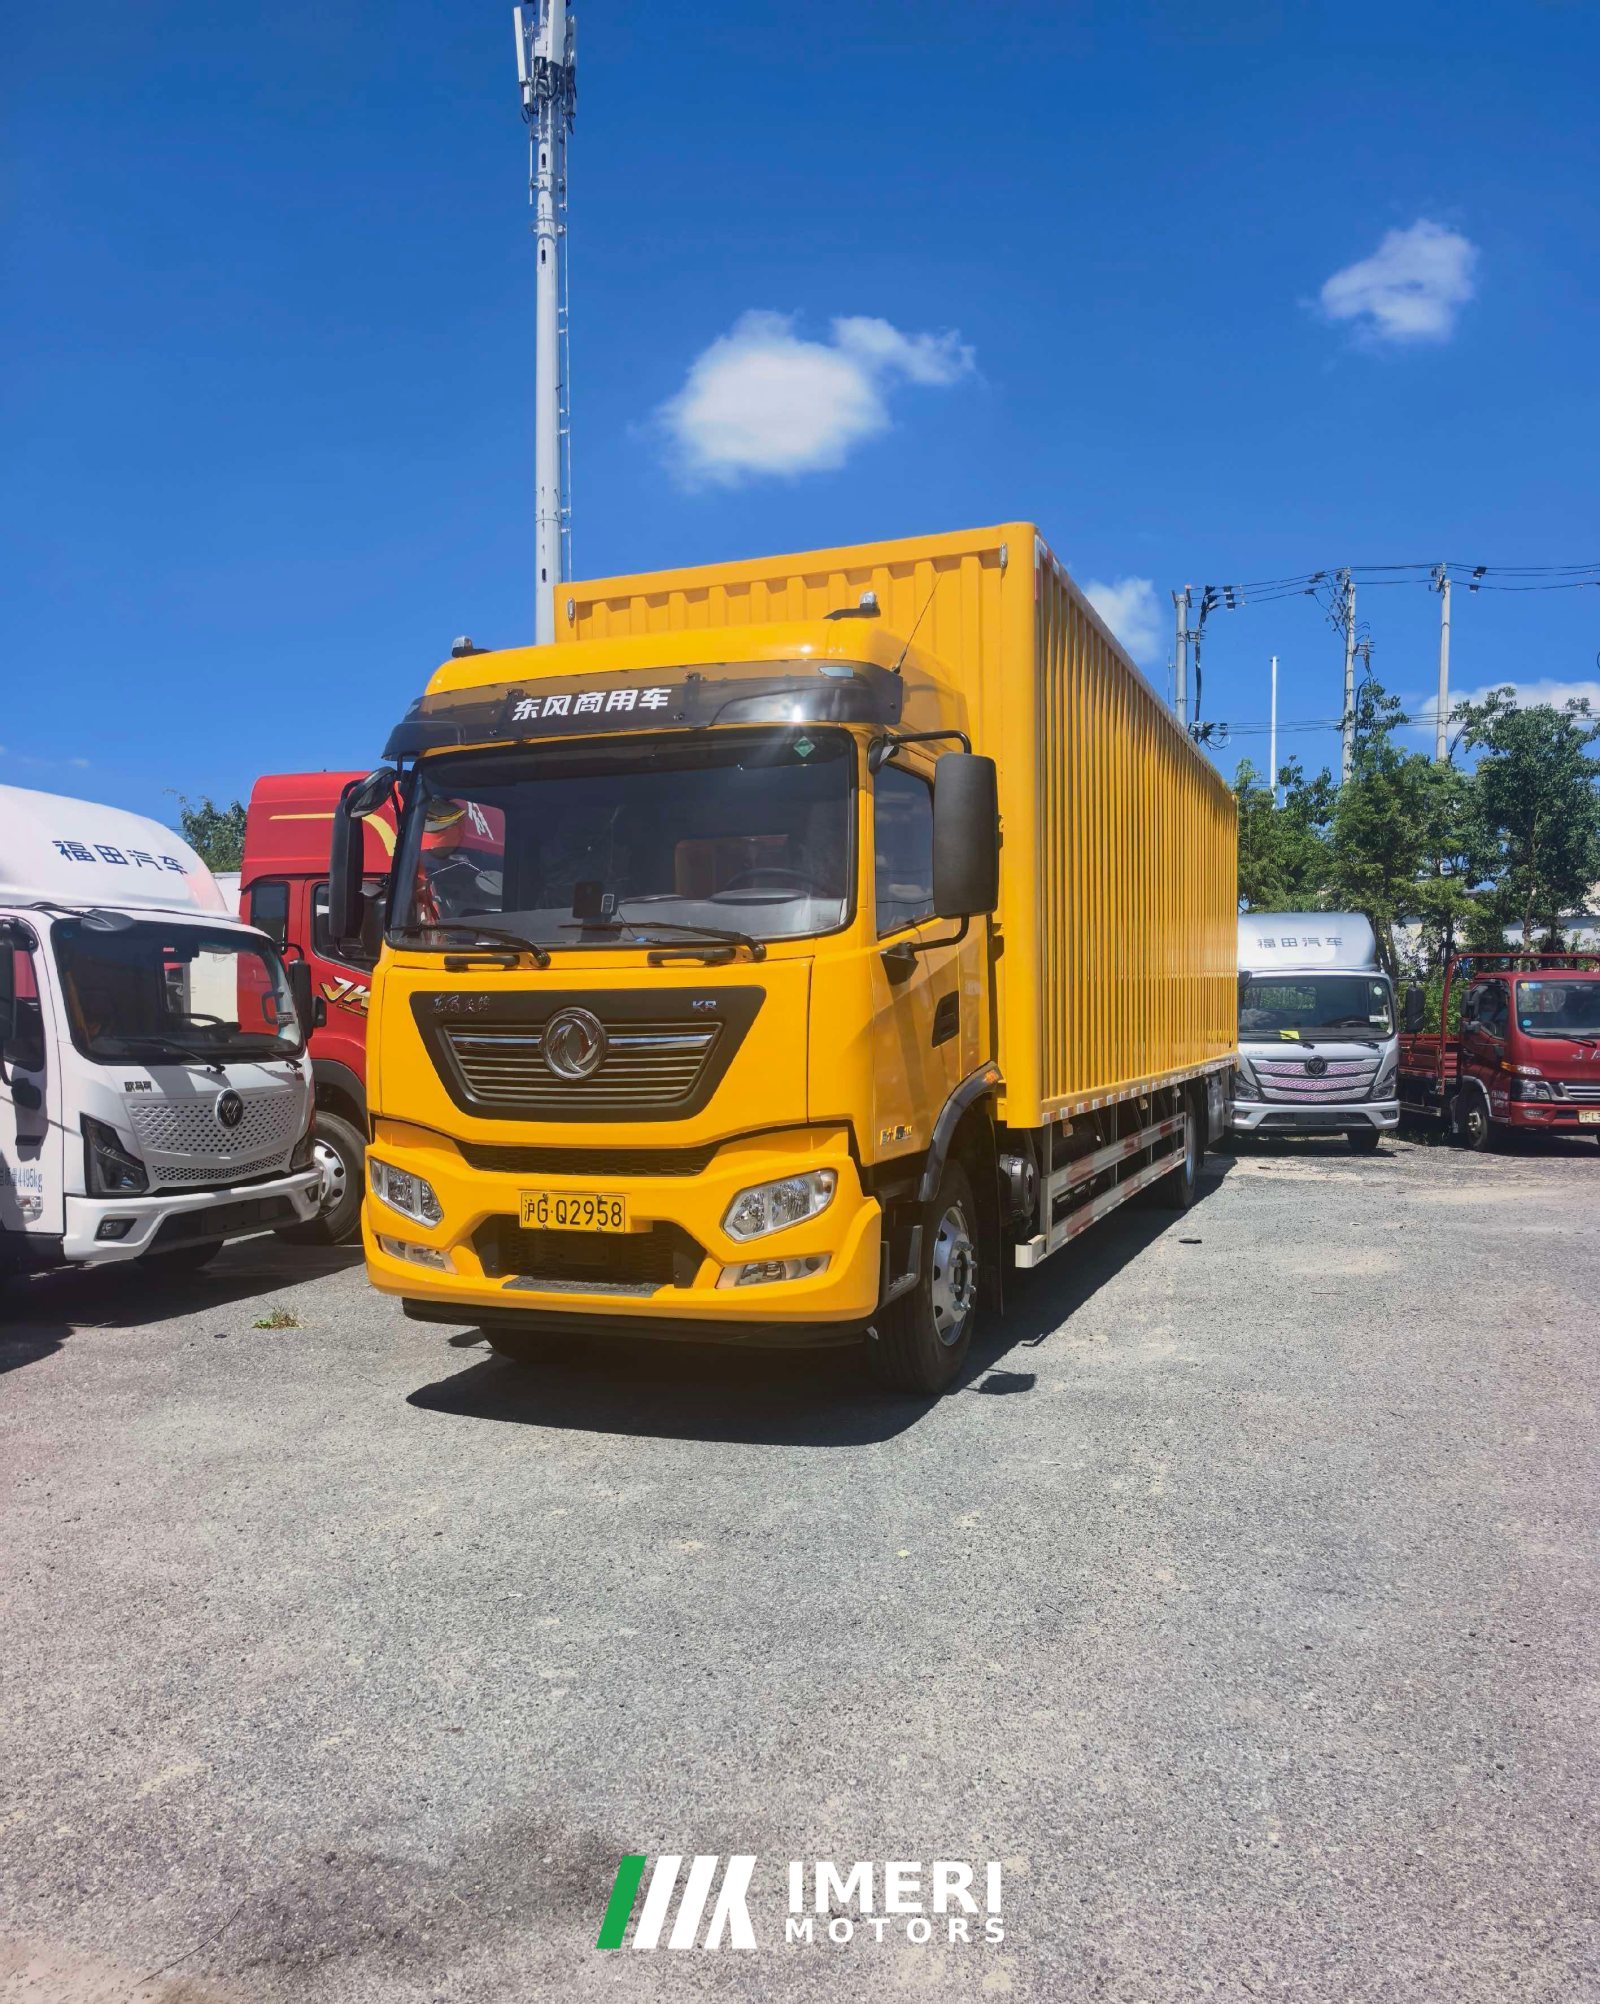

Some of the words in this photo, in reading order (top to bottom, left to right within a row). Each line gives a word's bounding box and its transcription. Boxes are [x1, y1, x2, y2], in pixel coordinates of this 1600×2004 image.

[511, 687, 673, 721] 东风商用车
[52, 840, 188, 875] 福田汽车
[1257, 937, 1343, 949] 福田汽车
